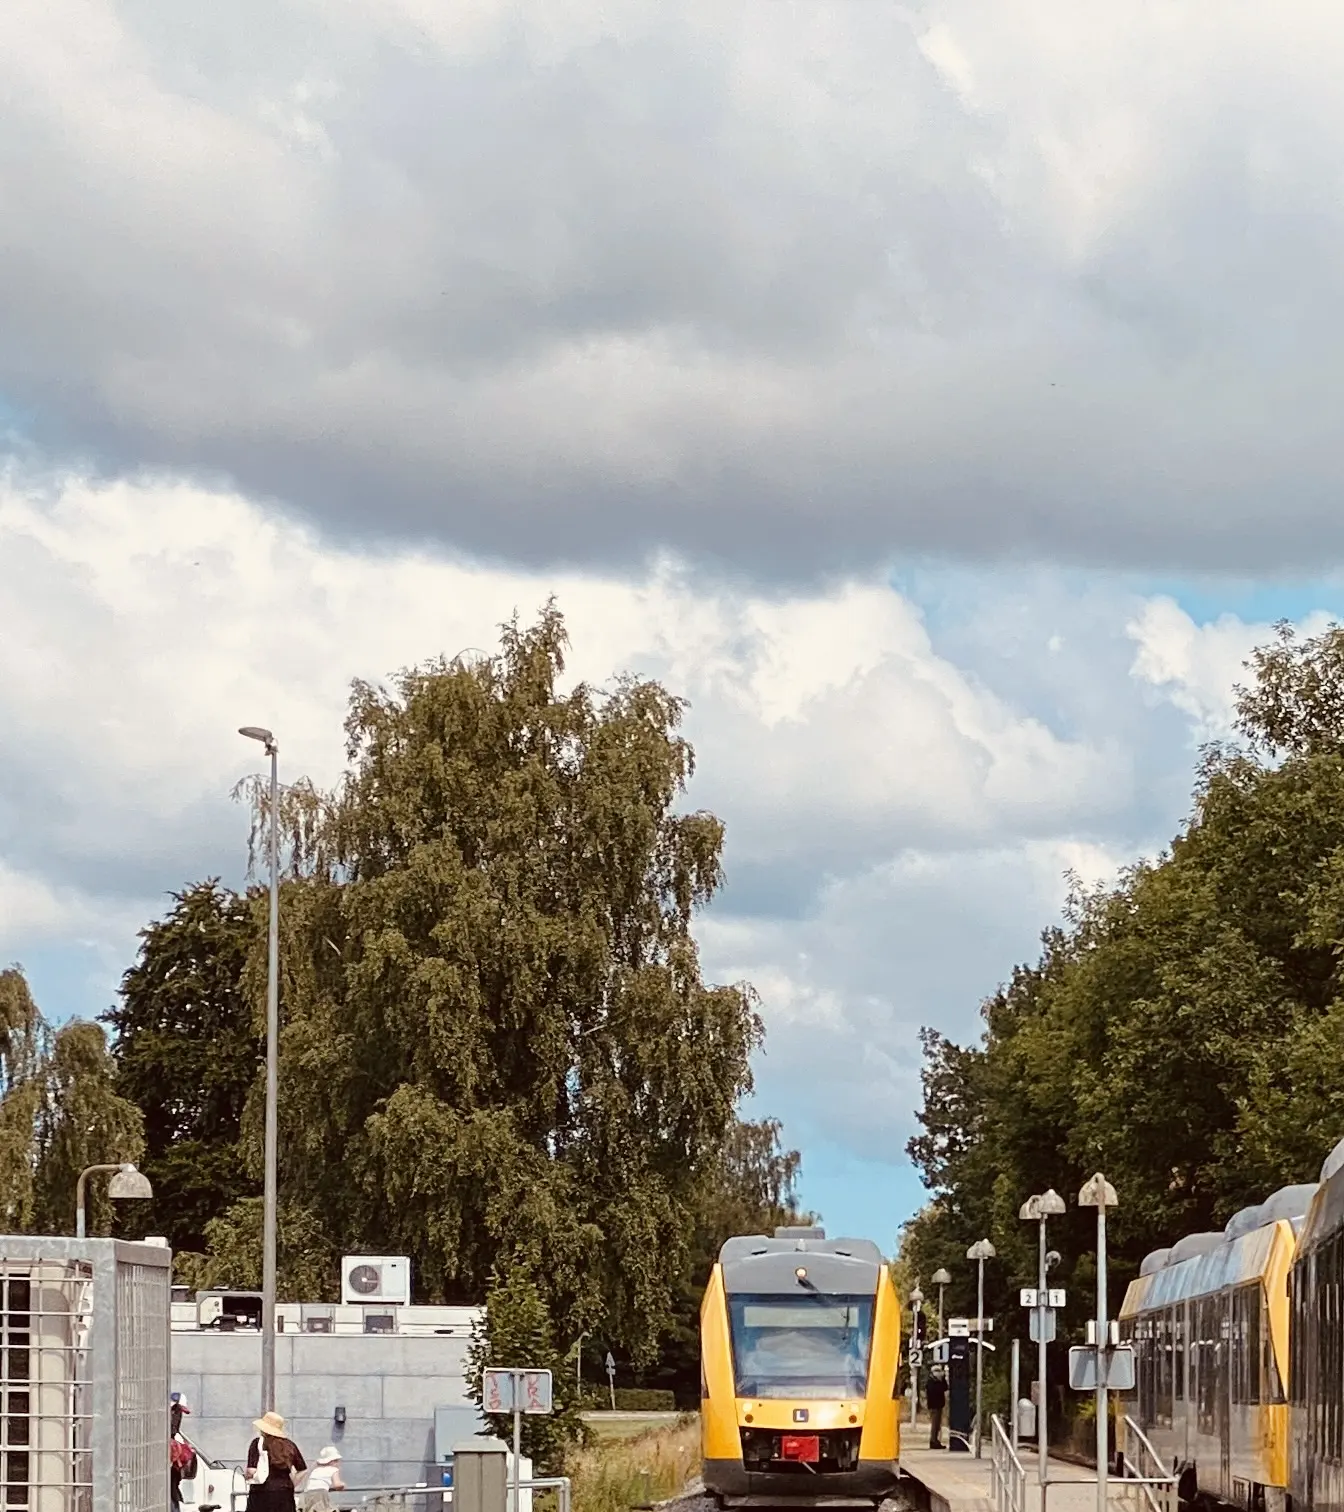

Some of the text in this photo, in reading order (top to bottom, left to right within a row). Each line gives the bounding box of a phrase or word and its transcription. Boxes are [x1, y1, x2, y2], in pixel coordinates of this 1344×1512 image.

[1025, 1294, 1031, 1304] 2
[1054, 1294, 1059, 1304] 1
[911, 1351, 920, 1364] 2
[938, 1344, 944, 1360] 1
[796, 1410, 805, 1421] L
